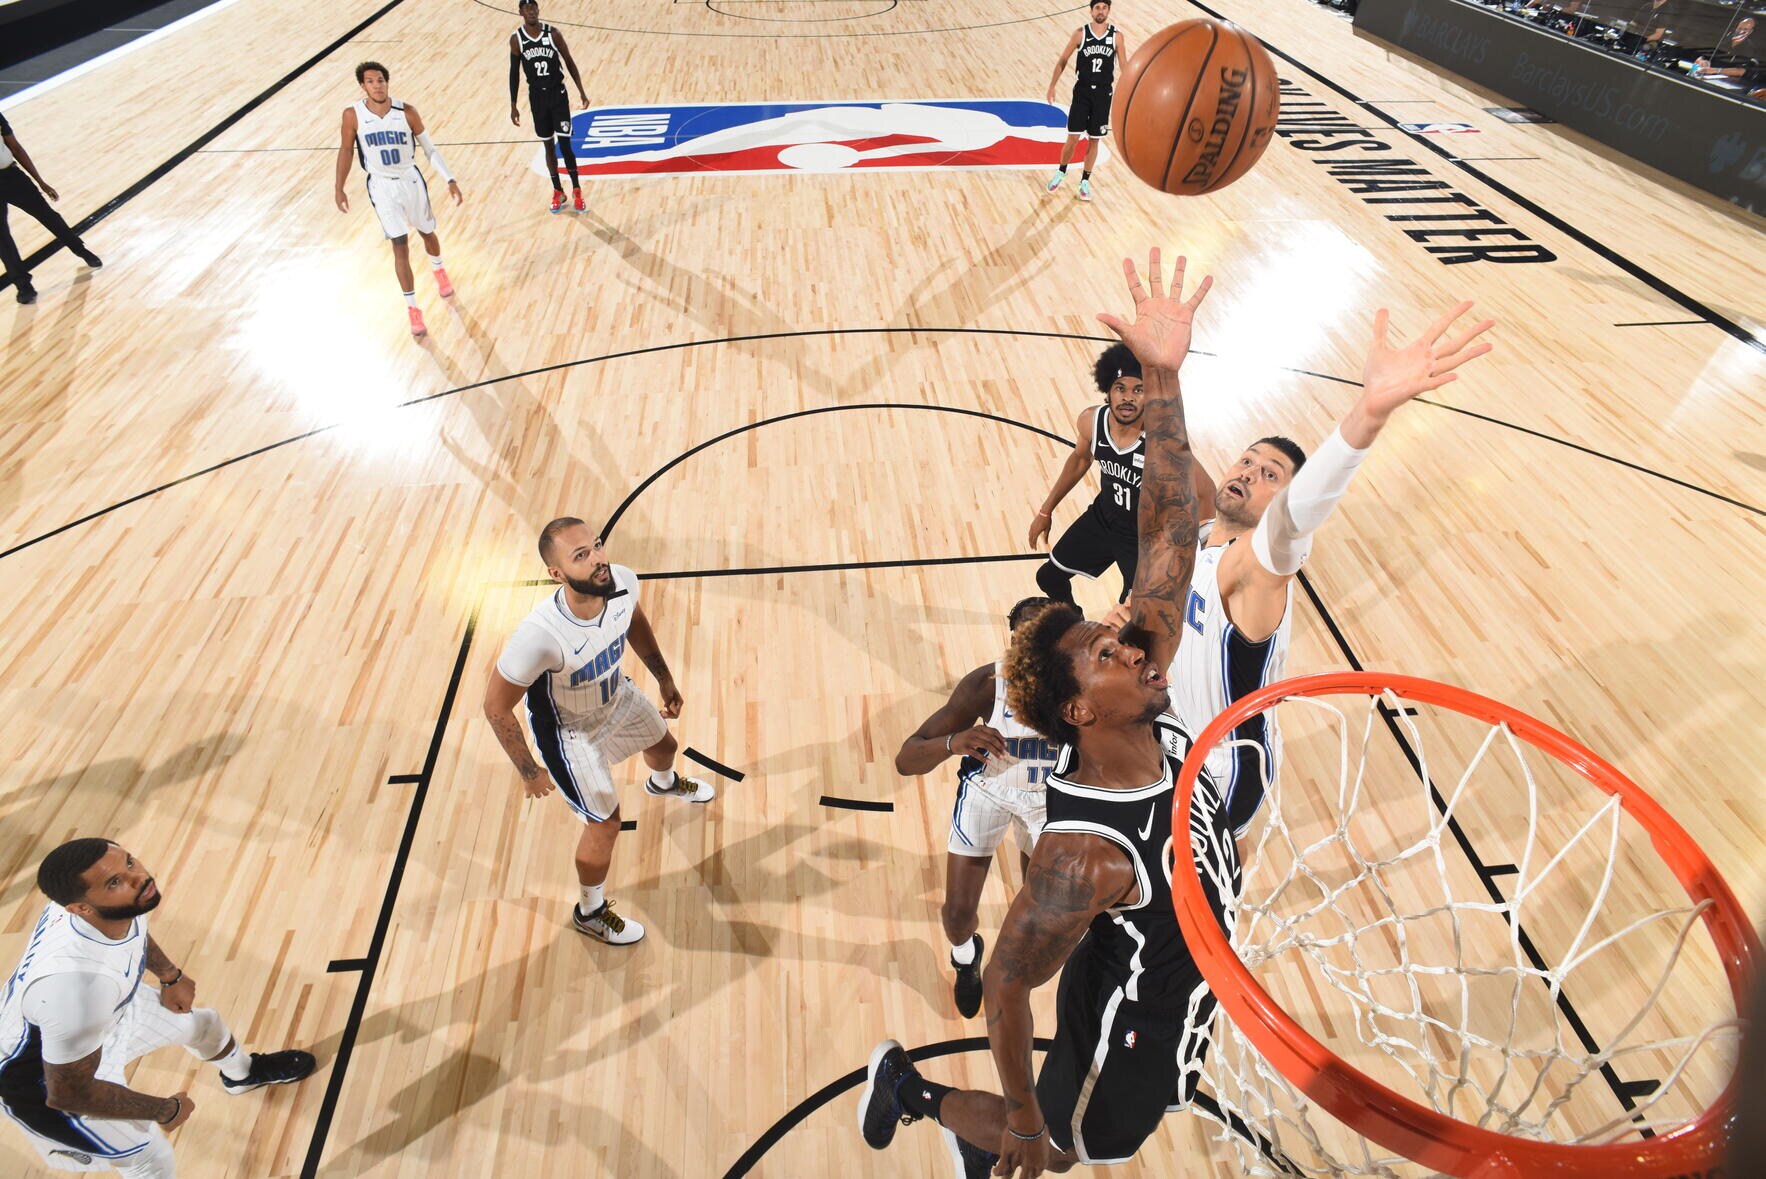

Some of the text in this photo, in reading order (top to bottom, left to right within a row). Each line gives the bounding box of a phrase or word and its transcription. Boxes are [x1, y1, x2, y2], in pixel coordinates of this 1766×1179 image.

[1082, 45, 1113, 57] BROOKLYN
[1416, 15, 1491, 64] BARCLAYS
[523, 47, 555, 60] BROOKLYN
[1092, 58, 1103, 73] 12
[534, 61, 550, 76] 22
[1511, 51, 1669, 143] BarclaysUS.com
[364, 130, 408, 147] MAGIC
[581, 113, 672, 149] NBA
[1182, 66, 1248, 187] SPALDING
[380, 148, 401, 166] 00
[1311, 158, 1558, 266] MATTER
[1112, 482, 1131, 511] 31
[570, 632, 626, 688] MAGI
[1167, 732, 1178, 756] infor
